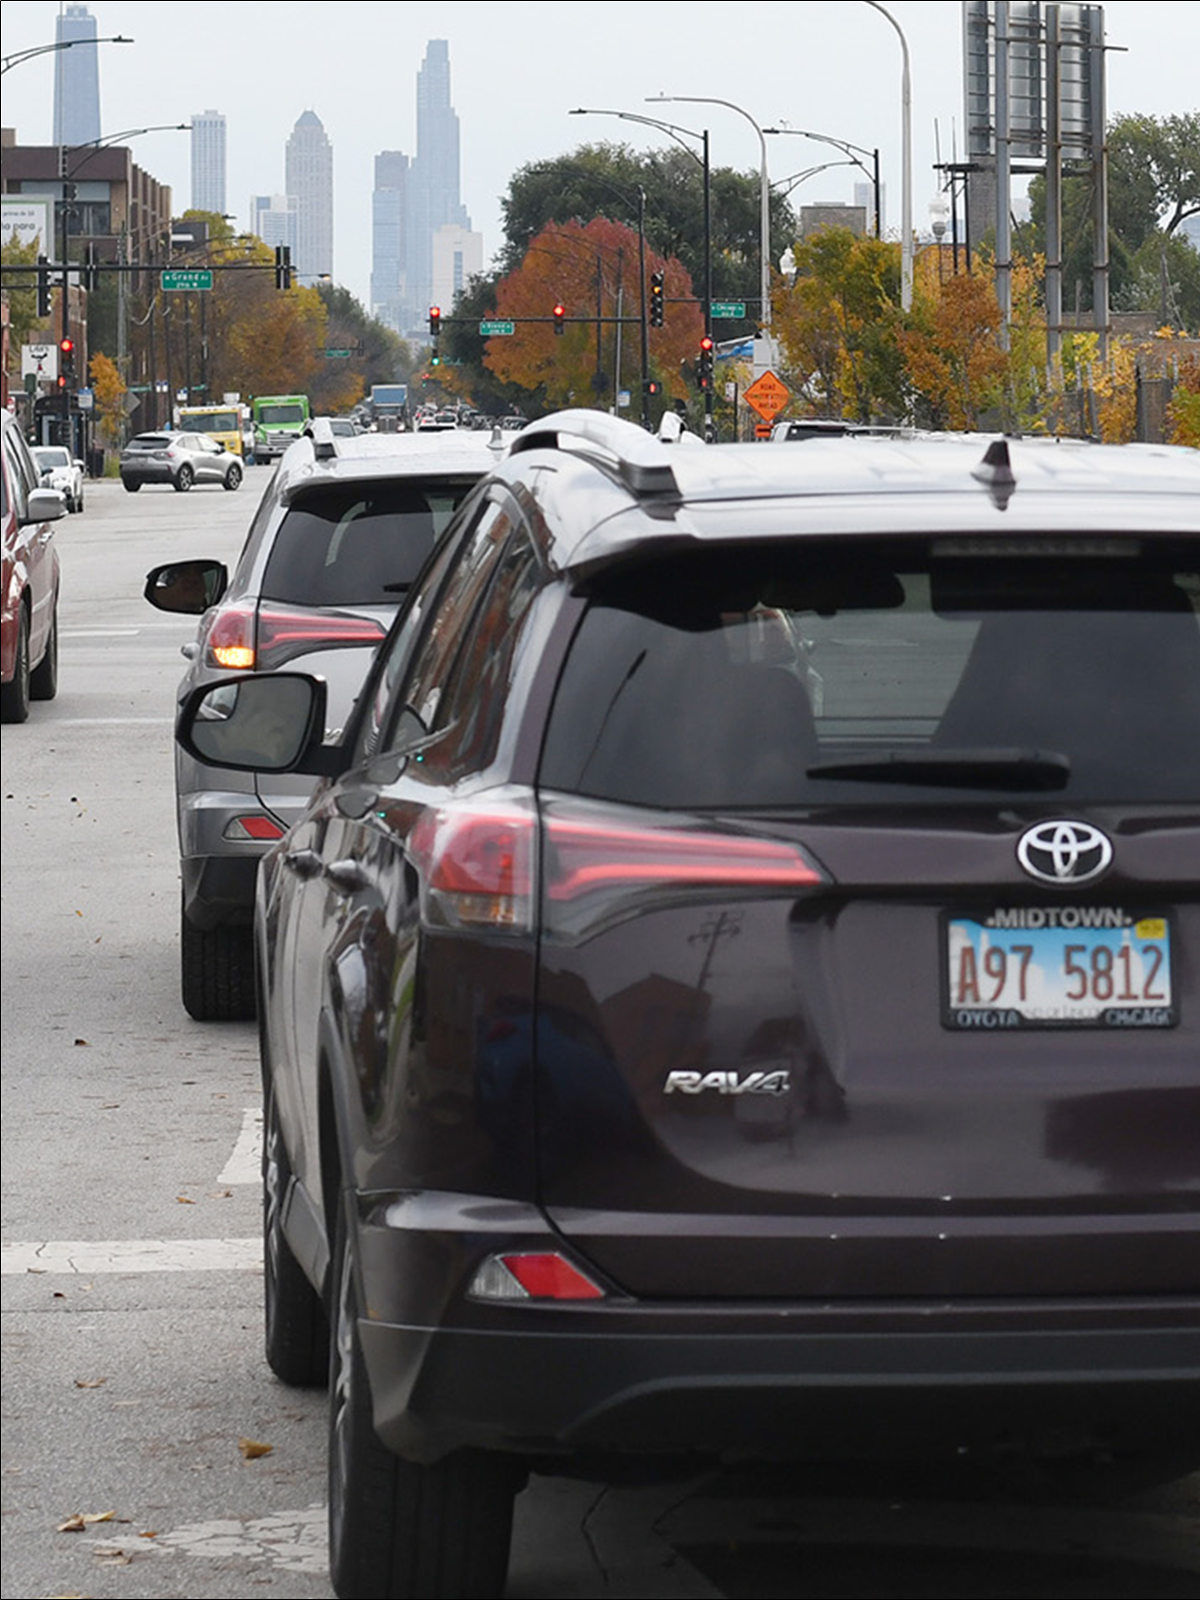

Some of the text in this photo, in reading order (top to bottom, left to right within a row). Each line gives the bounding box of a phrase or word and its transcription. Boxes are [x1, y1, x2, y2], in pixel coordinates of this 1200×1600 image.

[993, 908, 1123, 928] MIDTOWN
[957, 944, 1165, 1003] A97 5812
[956, 1009, 1019, 1027] OYOTA
[663, 1070, 790, 1096] RAV4
